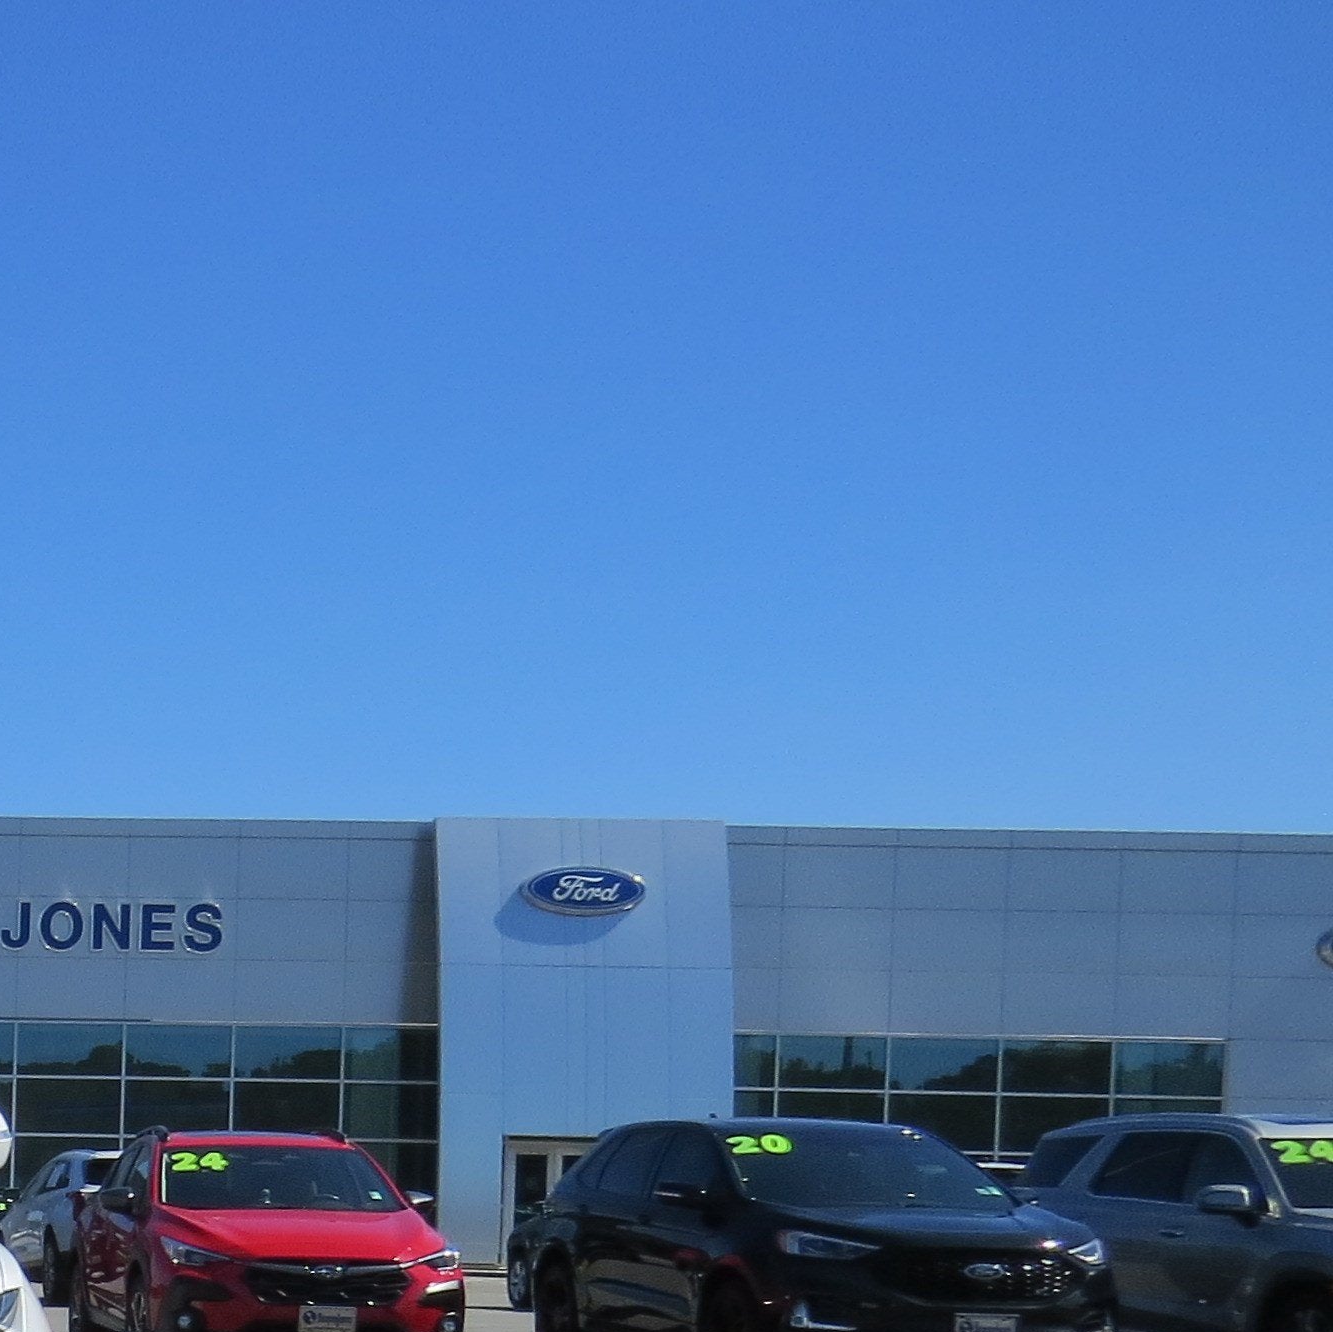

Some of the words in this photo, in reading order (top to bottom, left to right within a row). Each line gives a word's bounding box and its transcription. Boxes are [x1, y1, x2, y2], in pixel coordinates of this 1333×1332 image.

[552, 875, 621, 902] Ford
[0, 900, 223, 952] JONES
[725, 1133, 793, 1155] 20
[170, 1151, 230, 1172] 24
